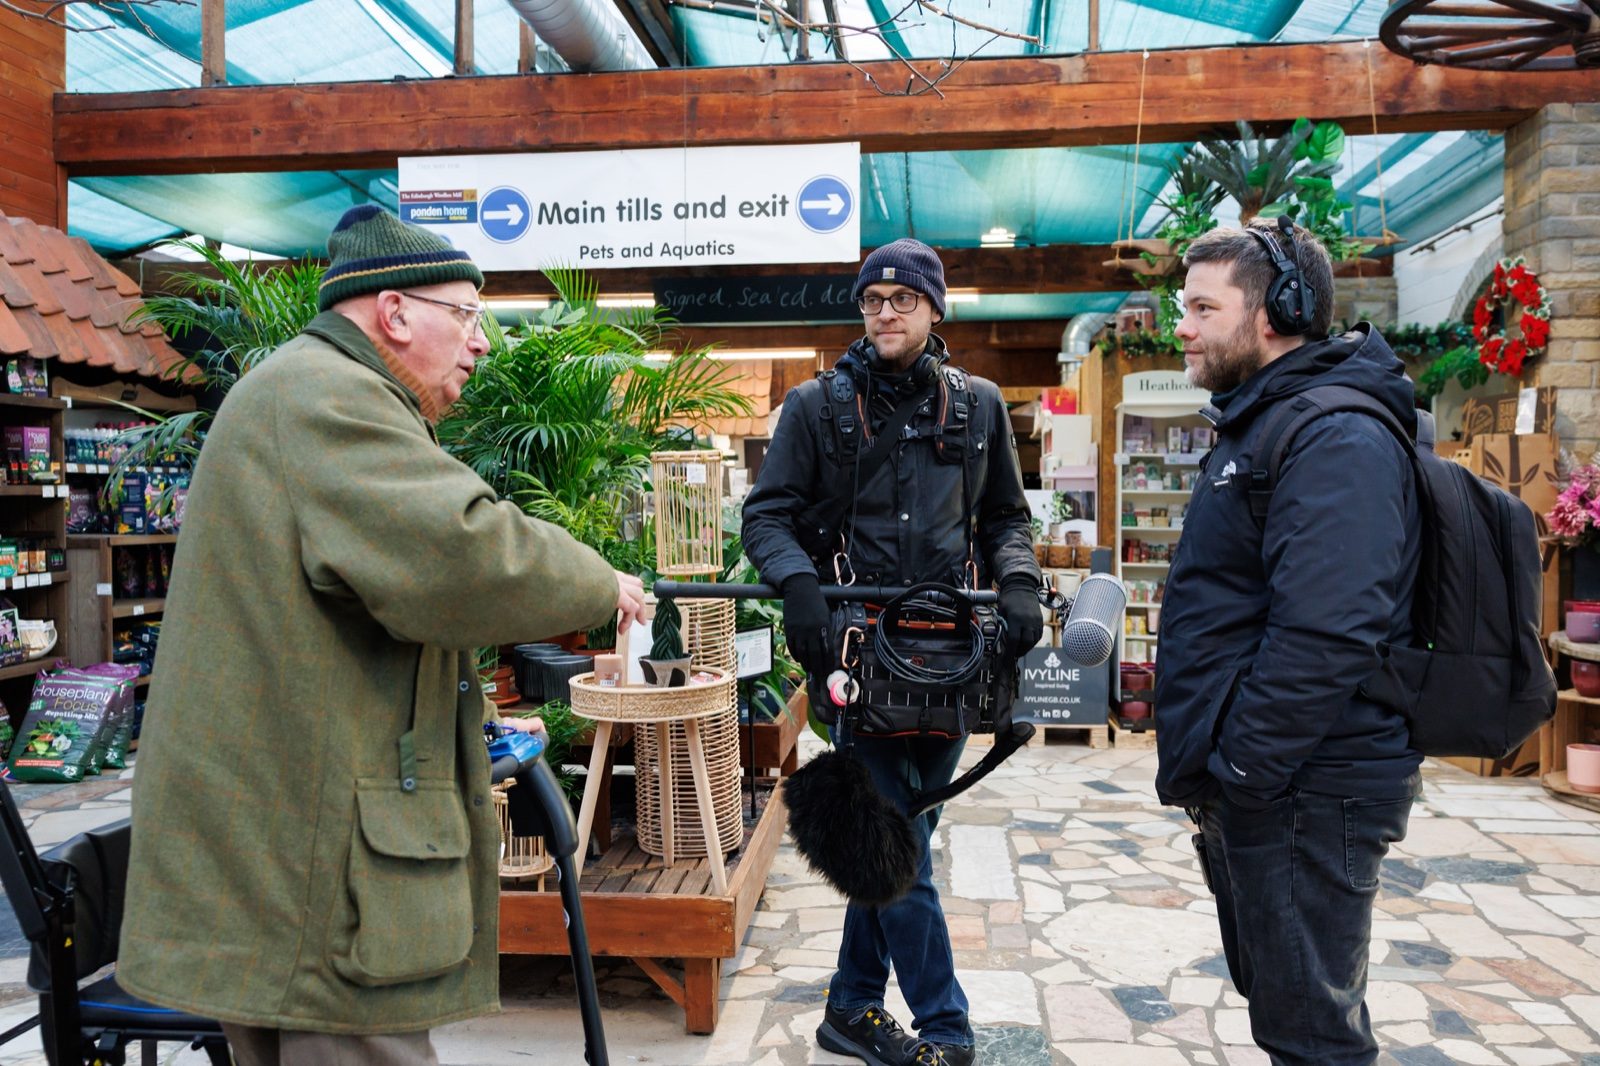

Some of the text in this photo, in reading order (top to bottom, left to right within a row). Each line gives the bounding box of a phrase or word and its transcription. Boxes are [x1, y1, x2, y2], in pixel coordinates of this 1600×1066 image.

[410, 192, 434, 200] Edinburgh
[411, 205, 467, 219] ponden home
[538, 193, 790, 225] Main tills and exit
[580, 240, 735, 260] Pets and Aquatics
[1025, 668, 1080, 681] IVYLINE
[33, 685, 108, 702] Houseplant
[1024, 696, 1080, 704] IVYLINEGB.CO.UK
[54, 696, 98, 713] Focus
[45, 709, 83, 720] Repotting
